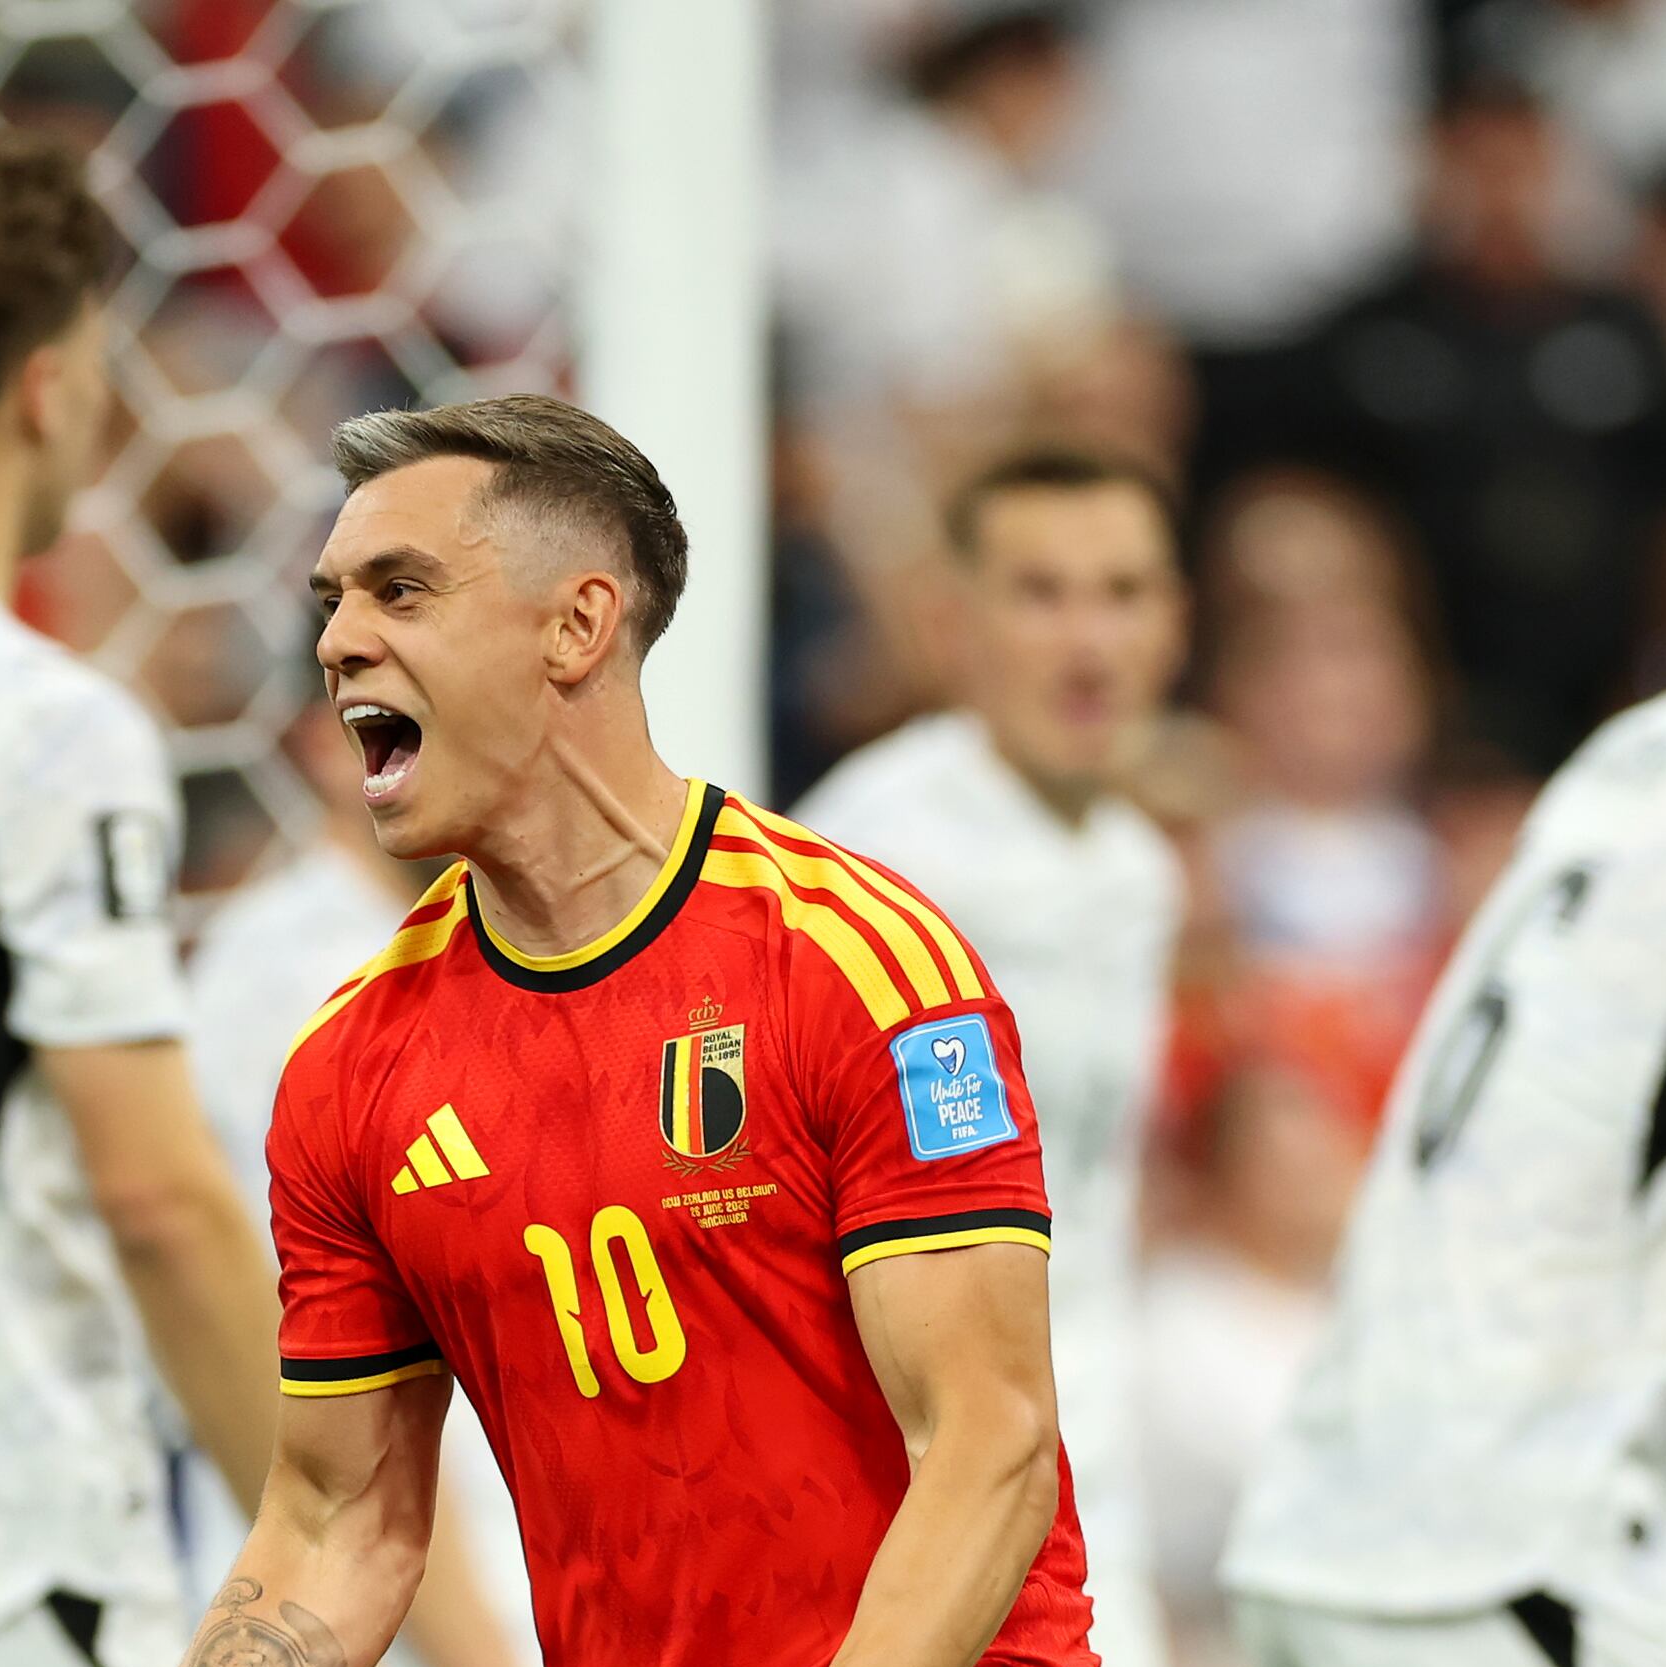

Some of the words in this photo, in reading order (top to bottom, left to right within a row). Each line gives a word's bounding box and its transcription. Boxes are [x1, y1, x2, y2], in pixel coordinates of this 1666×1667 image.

[703, 1031, 732, 1044] ROYAL
[703, 1039, 741, 1054] BELGIAN
[930, 1078, 964, 1104] Unite
[962, 1073, 983, 1098] For
[937, 1098, 983, 1127] PEACE
[952, 1125, 977, 1140] FIFA
[682, 1189, 721, 1206] ZEALAND
[736, 1183, 778, 1198] BELGIUM
[703, 1203, 724, 1216] JUNE
[725, 1199, 750, 1213] 2026
[697, 1211, 748, 1229] VANCOUVER
[523, 1204, 687, 1399] 10
